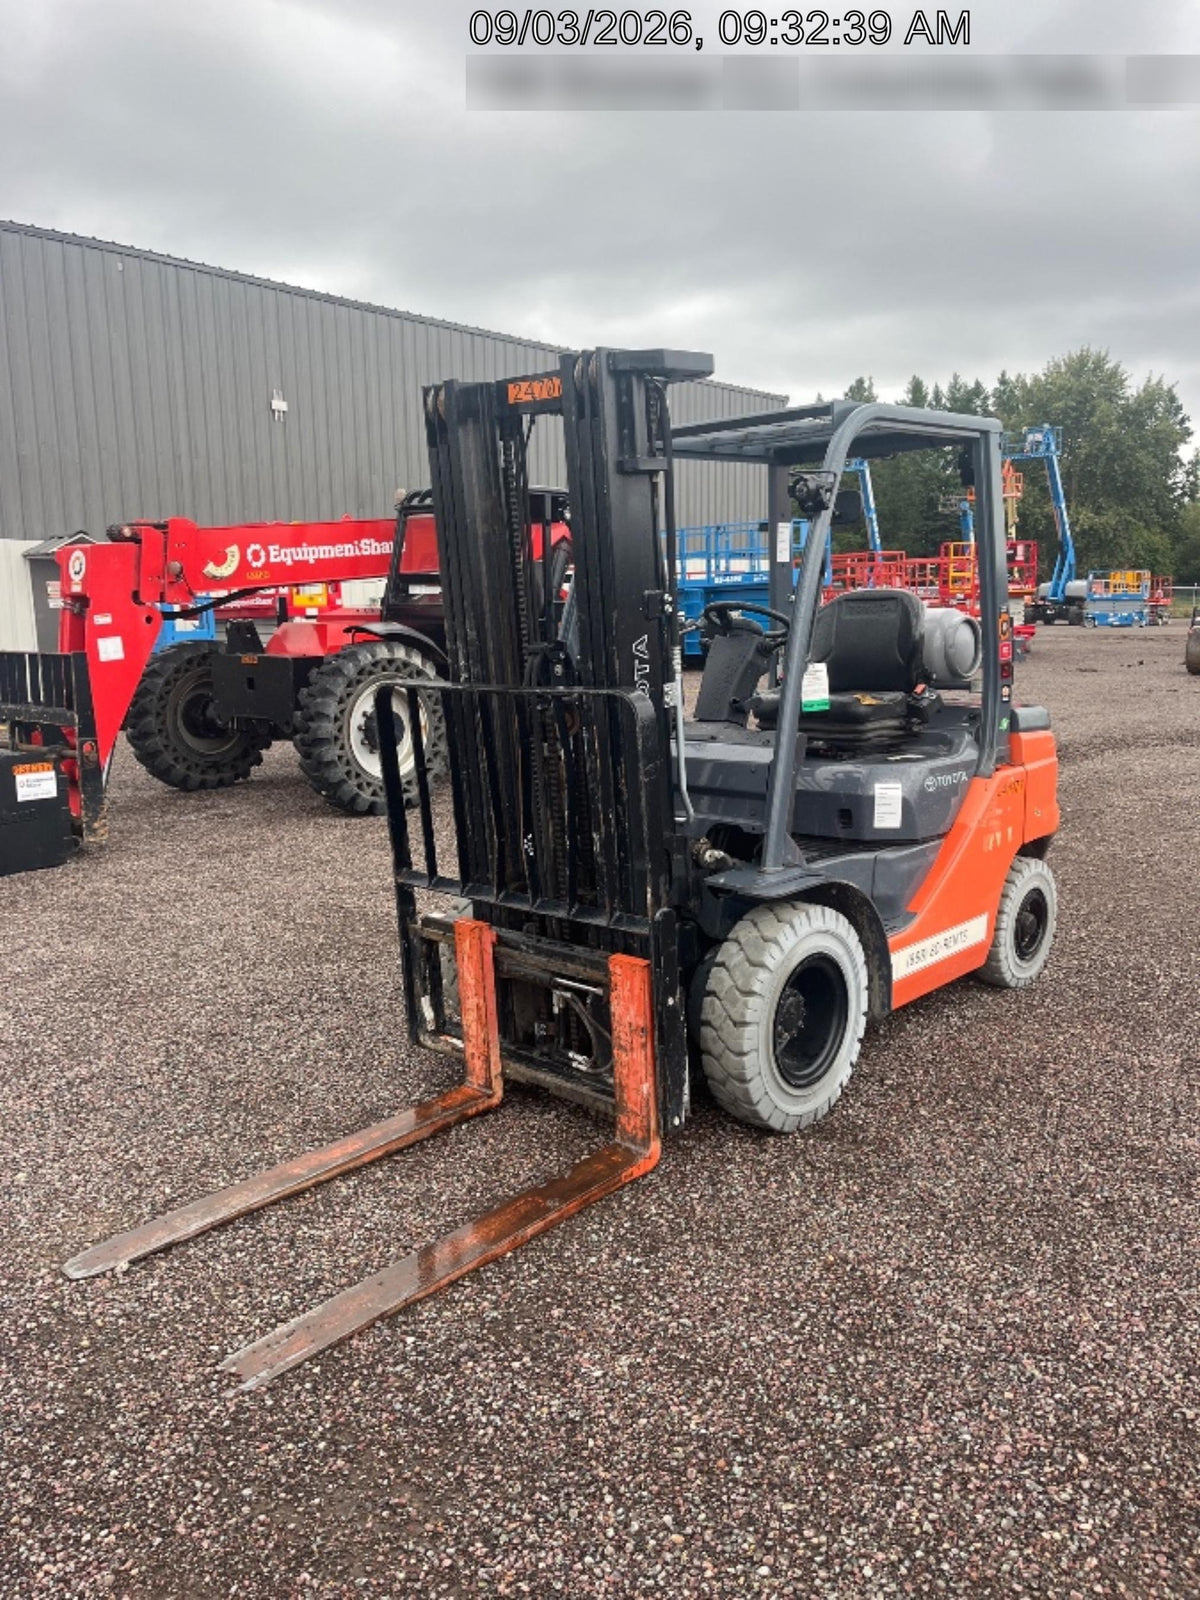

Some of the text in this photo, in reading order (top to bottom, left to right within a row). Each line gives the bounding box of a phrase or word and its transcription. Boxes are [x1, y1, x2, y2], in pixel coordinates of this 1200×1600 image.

[268, 538, 406, 566] EquipmentSha
[632, 634, 650, 699] OTA
[936, 770, 969, 787] TOYOTA
